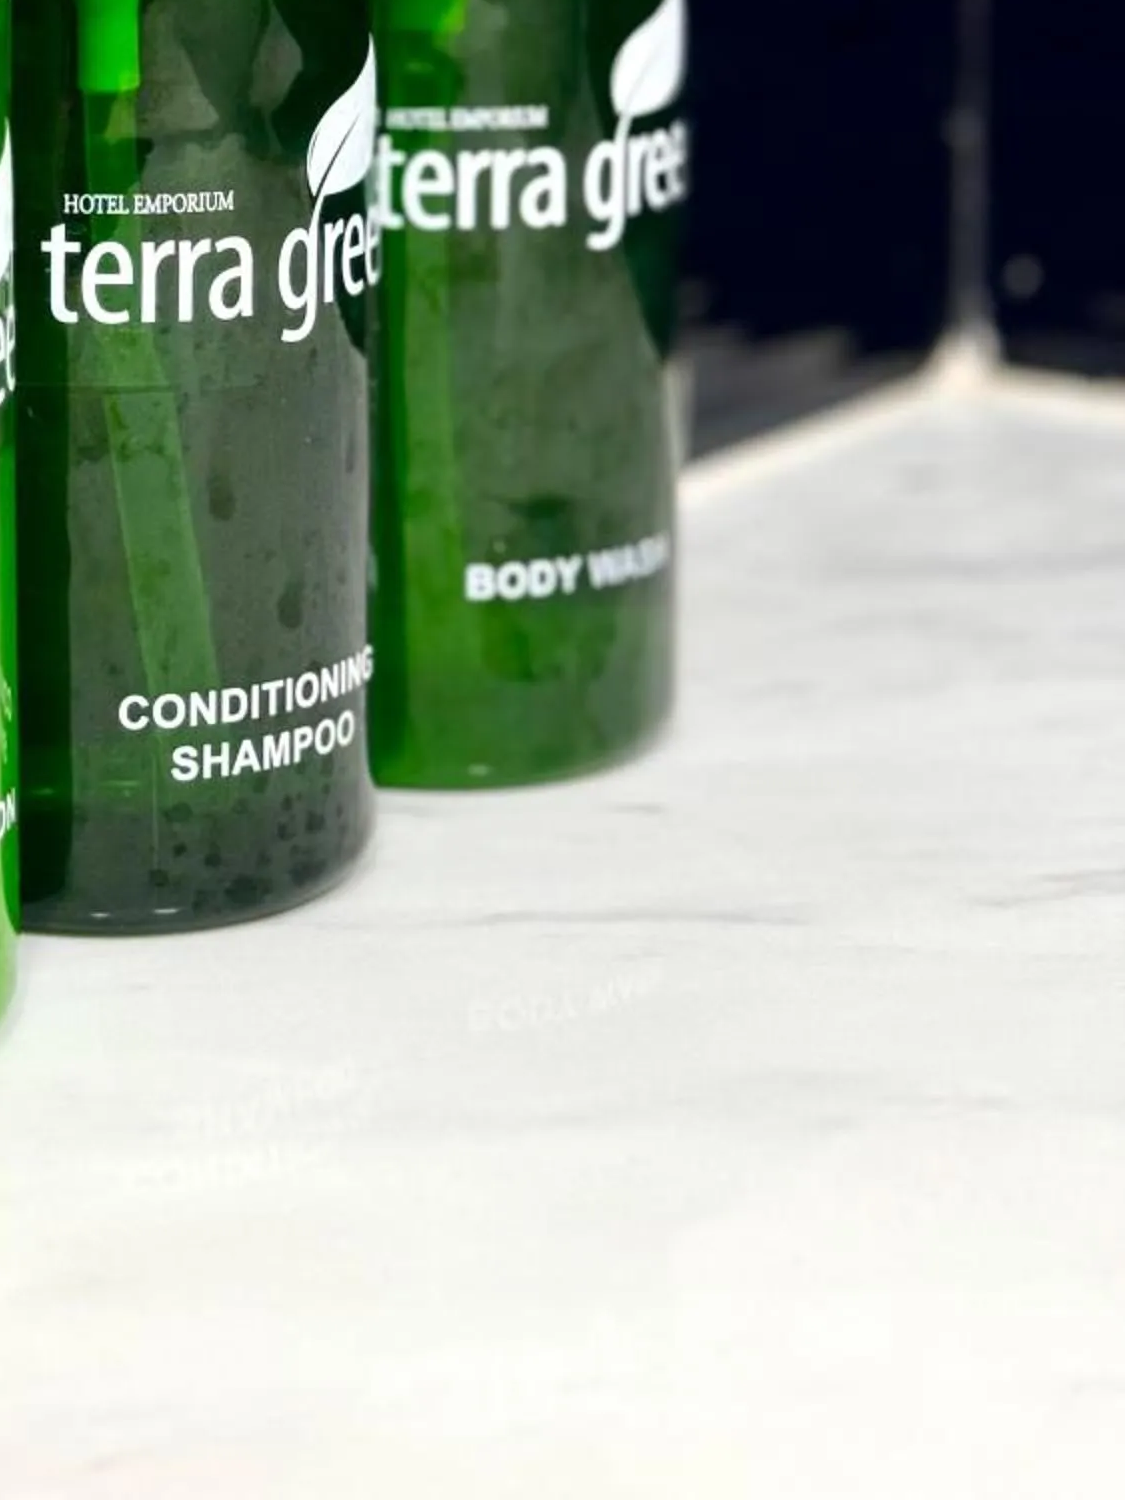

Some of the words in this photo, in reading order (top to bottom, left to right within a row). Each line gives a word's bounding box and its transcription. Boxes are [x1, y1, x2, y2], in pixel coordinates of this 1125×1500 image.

[63, 193, 130, 215] HOTEL
[133, 190, 235, 215] EMPORIUM
[373, 134, 567, 231] terra
[41, 223, 255, 325] terra
[465, 555, 582, 601] BODY
[118, 644, 374, 731] CONDITIONING
[170, 709, 356, 782] SHAMPOO
